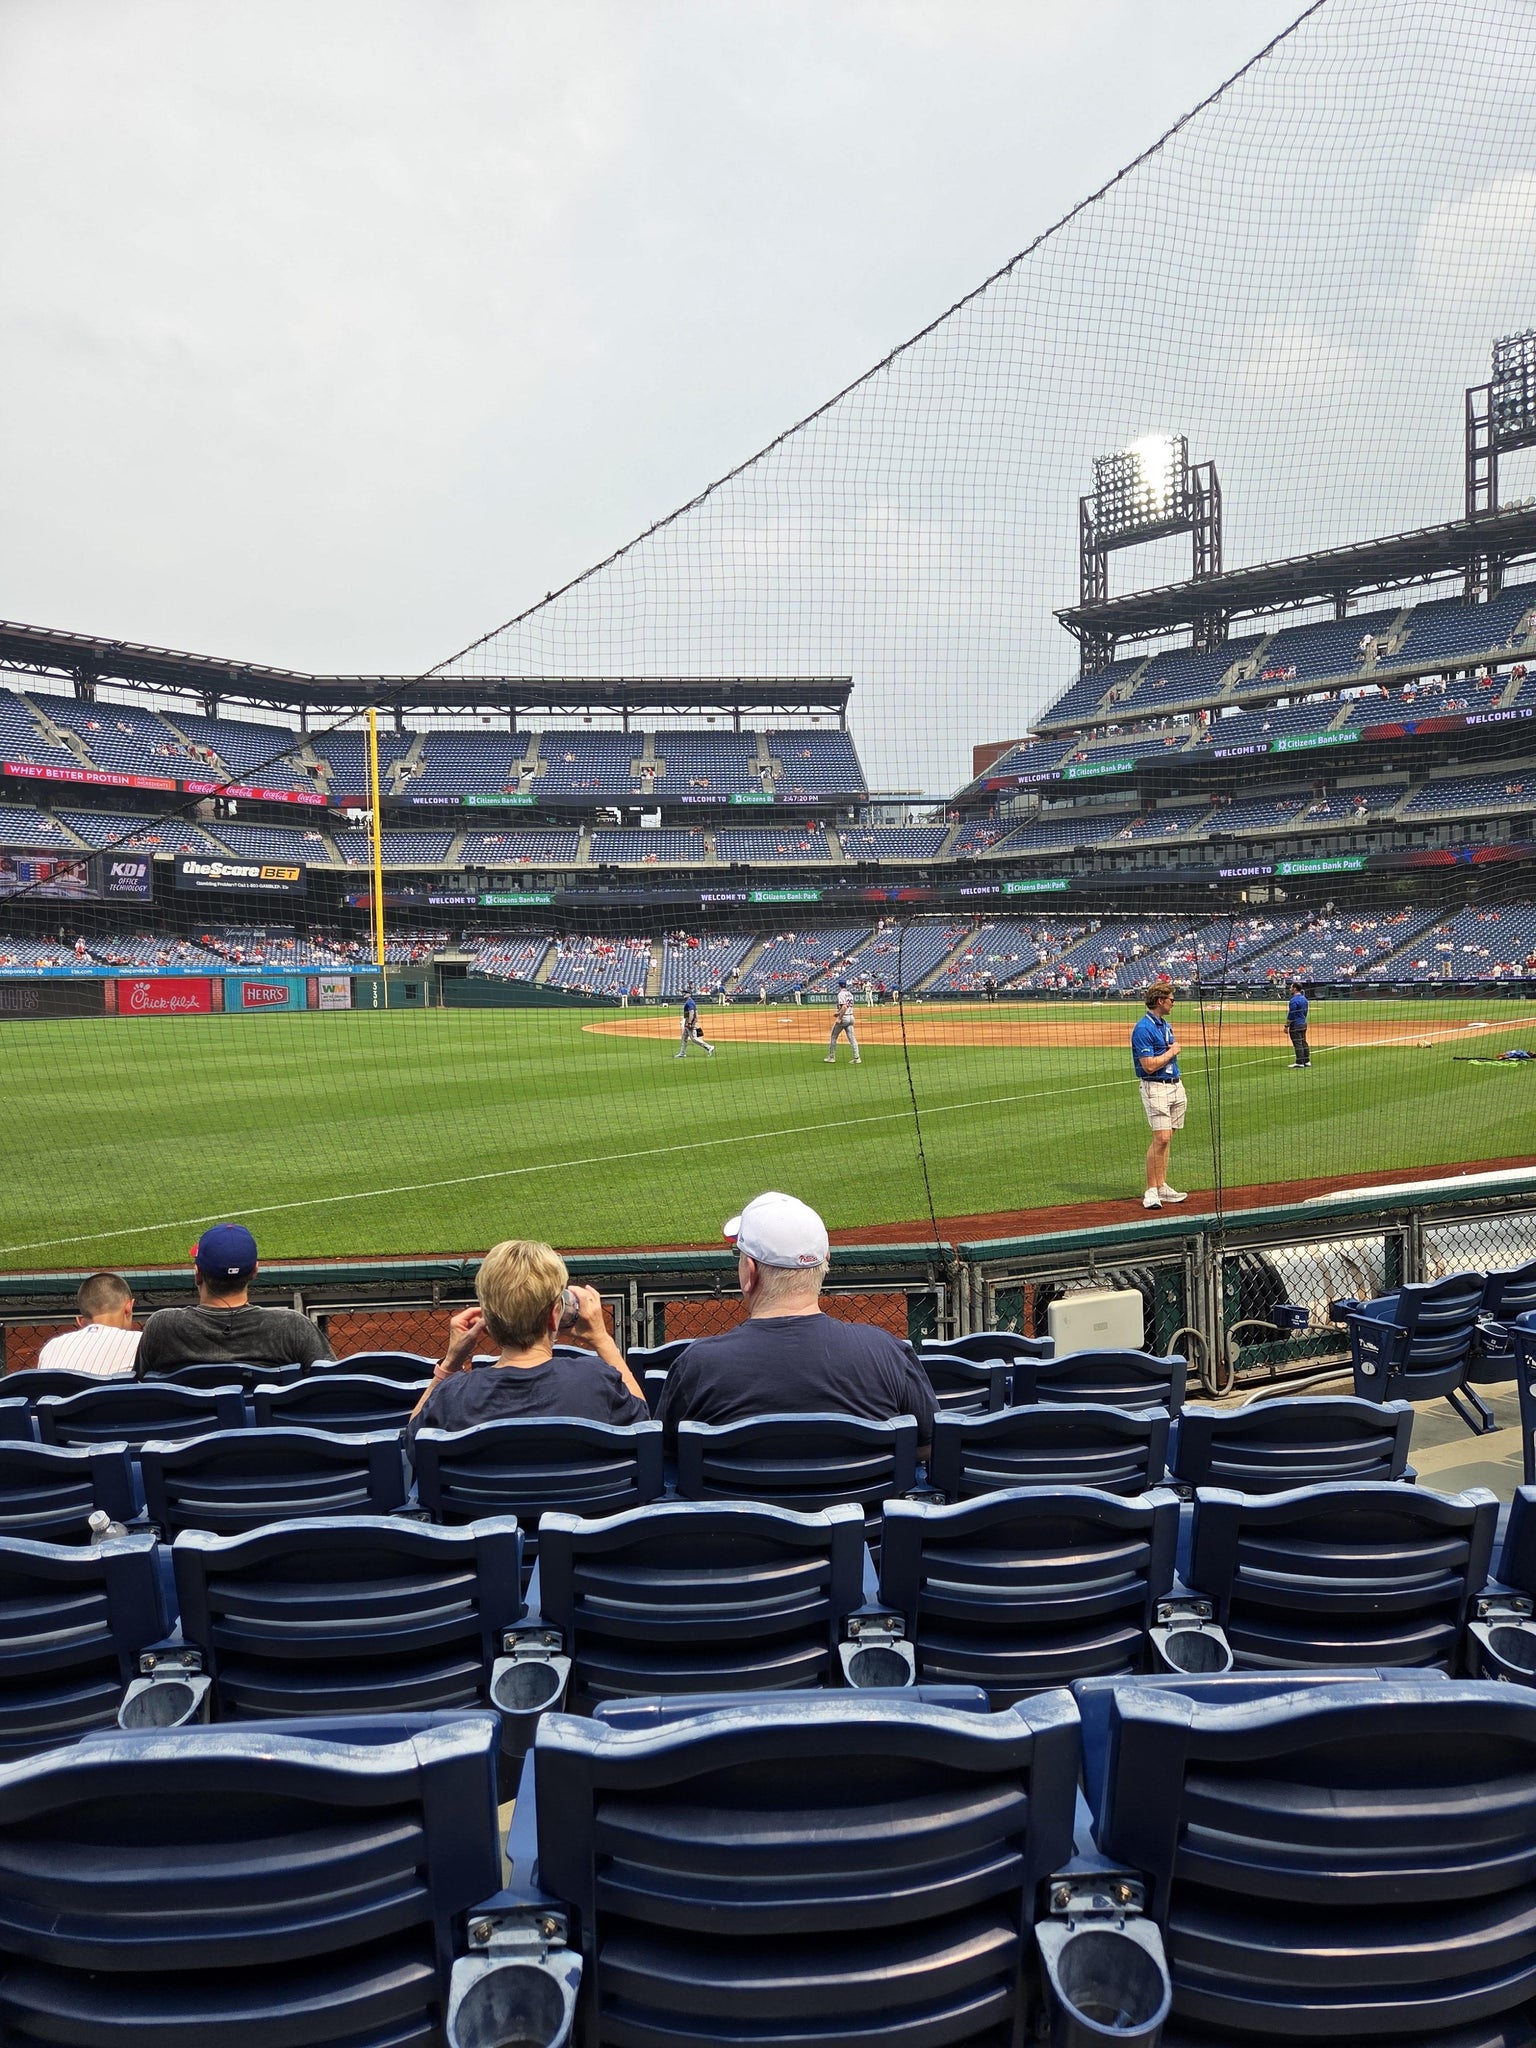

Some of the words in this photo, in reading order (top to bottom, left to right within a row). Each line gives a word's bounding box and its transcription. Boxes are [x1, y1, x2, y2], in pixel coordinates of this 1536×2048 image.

[1466, 711, 1516, 724] WELCOME
[1520, 709, 1533, 717] TO
[1214, 746, 1254, 757] WELCOME
[1256, 744, 1267, 752] TO
[1287, 739, 1316, 749] Citizens
[1318, 735, 1337, 744] Bank
[1339, 731, 1357, 742] Park
[10, 765, 43, 776] WHEY
[46, 769, 84, 780] BETTER
[86, 774, 129, 785] PROTEIN
[1018, 772, 1051, 783] WELCOME
[1052, 771, 1060, 779] TO
[1077, 767, 1100, 776] Citizens
[1101, 764, 1116, 772] Bank
[1118, 762, 1132, 771] Park
[501, 796, 517, 804] Bank
[518, 796, 533, 804] Park
[110, 862, 147, 877] KDI
[182, 861, 260, 877] theScore
[264, 869, 296, 879] BET
[1219, 868, 1259, 877] WELCOME
[1292, 863, 1321, 872] Citizens
[1323, 861, 1342, 869] Bank
[1343, 859, 1362, 868] Park
[109, 884, 147, 892] TECHNOLOGY
[960, 887, 991, 895] WELCOME
[1052, 880, 1066, 888] Park
[130, 982, 199, 1010] Chick-fil-A
[247, 989, 284, 1000] HERR'S
[322, 985, 346, 993] WM
